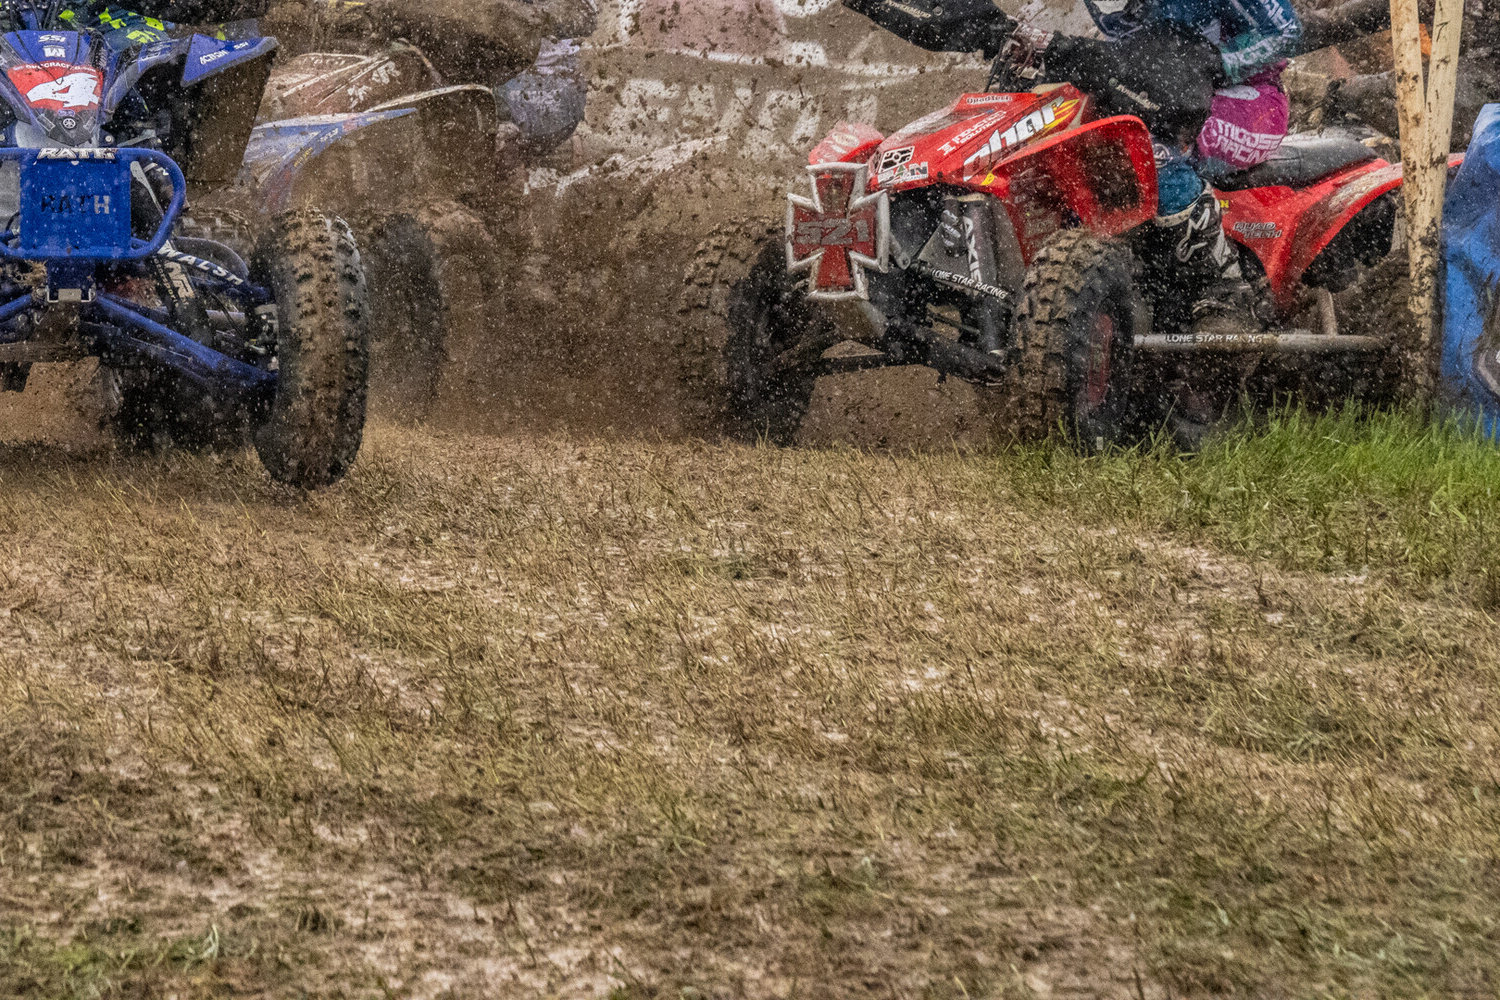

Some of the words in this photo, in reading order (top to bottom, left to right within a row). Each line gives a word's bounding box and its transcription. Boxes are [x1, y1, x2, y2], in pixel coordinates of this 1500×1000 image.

[26, 72, 99, 108] 4
[1216, 118, 1285, 151] MOOSE
[37, 147, 118, 159] RATH
[41, 194, 111, 215] RATH
[796, 218, 870, 246] 521
[157, 239, 244, 286] WALSH
[962, 215, 982, 283] AXIS
[952, 273, 975, 288] STAR
[974, 281, 1009, 300] RACING
[1166, 334, 1193, 343] LONE
[1195, 334, 1222, 343] STAR
